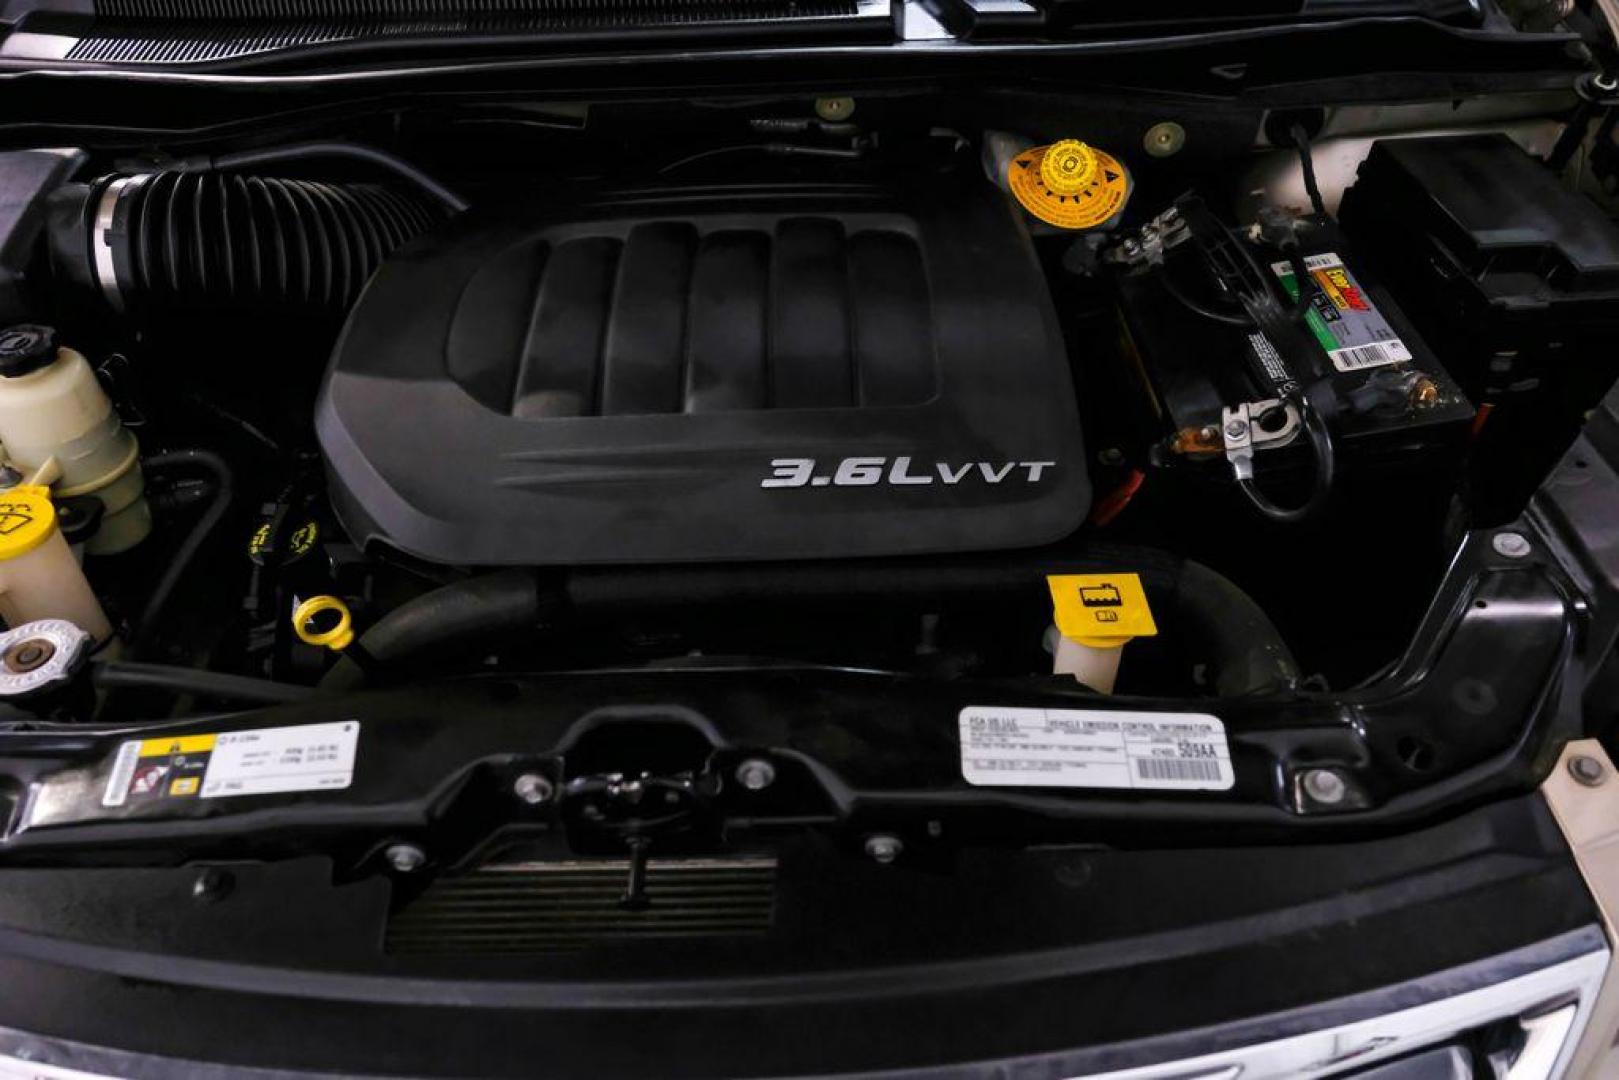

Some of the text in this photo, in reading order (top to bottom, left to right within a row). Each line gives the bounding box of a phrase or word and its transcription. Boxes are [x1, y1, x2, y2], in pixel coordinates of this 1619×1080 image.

[760, 456, 1056, 488] 3.6L VVT
[1121, 722, 1156, 732] CONTROL
